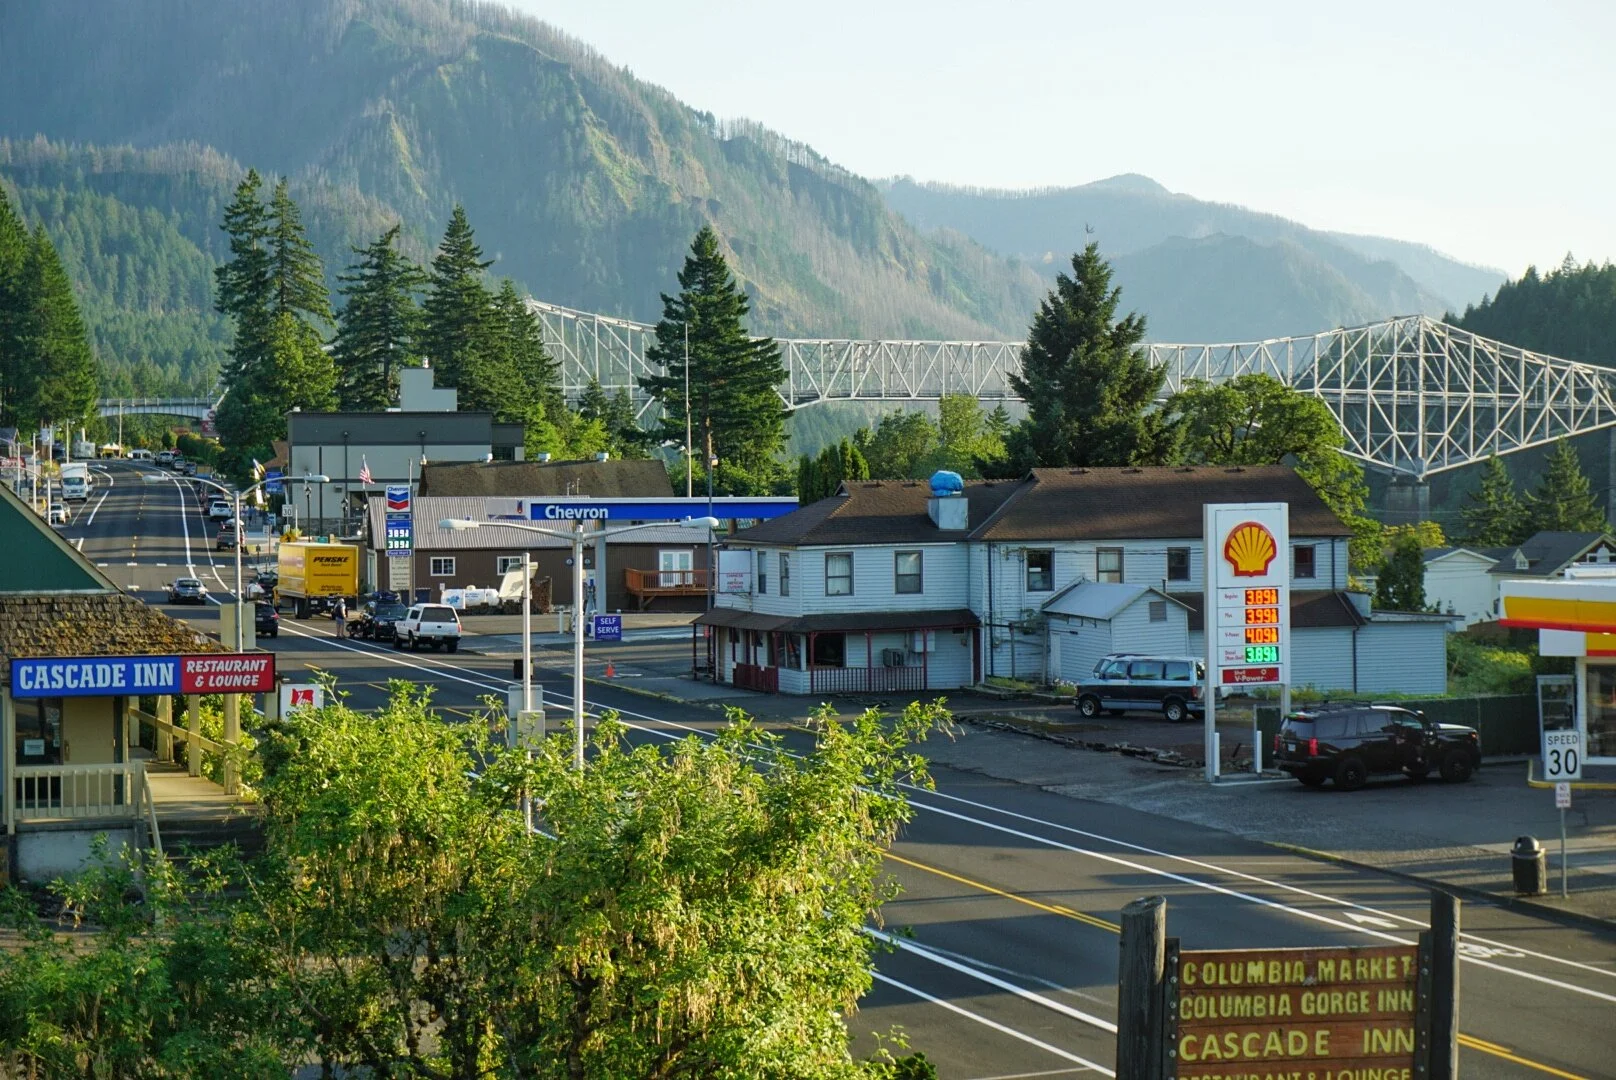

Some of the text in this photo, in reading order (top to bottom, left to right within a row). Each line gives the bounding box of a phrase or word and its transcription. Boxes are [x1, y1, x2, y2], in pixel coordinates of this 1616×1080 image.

[283, 508, 292, 516] 30
[545, 505, 608, 519] Chevron
[600, 617, 617, 625] SELF
[597, 626, 620, 634] SERVE
[186, 659, 268, 674] RESTAURANT
[20, 662, 175, 690] CASCADE INN
[195, 674, 260, 688] & LOUNGE
[1547, 735, 1578, 745] SPEED
[1549, 748, 1578, 775] 30
[1183, 955, 1412, 985] COLUMBIA MARKET
[1179, 989, 1414, 1020] COLUMBIA GORGE INN
[1179, 1028, 1415, 1062] CASCADE INN
